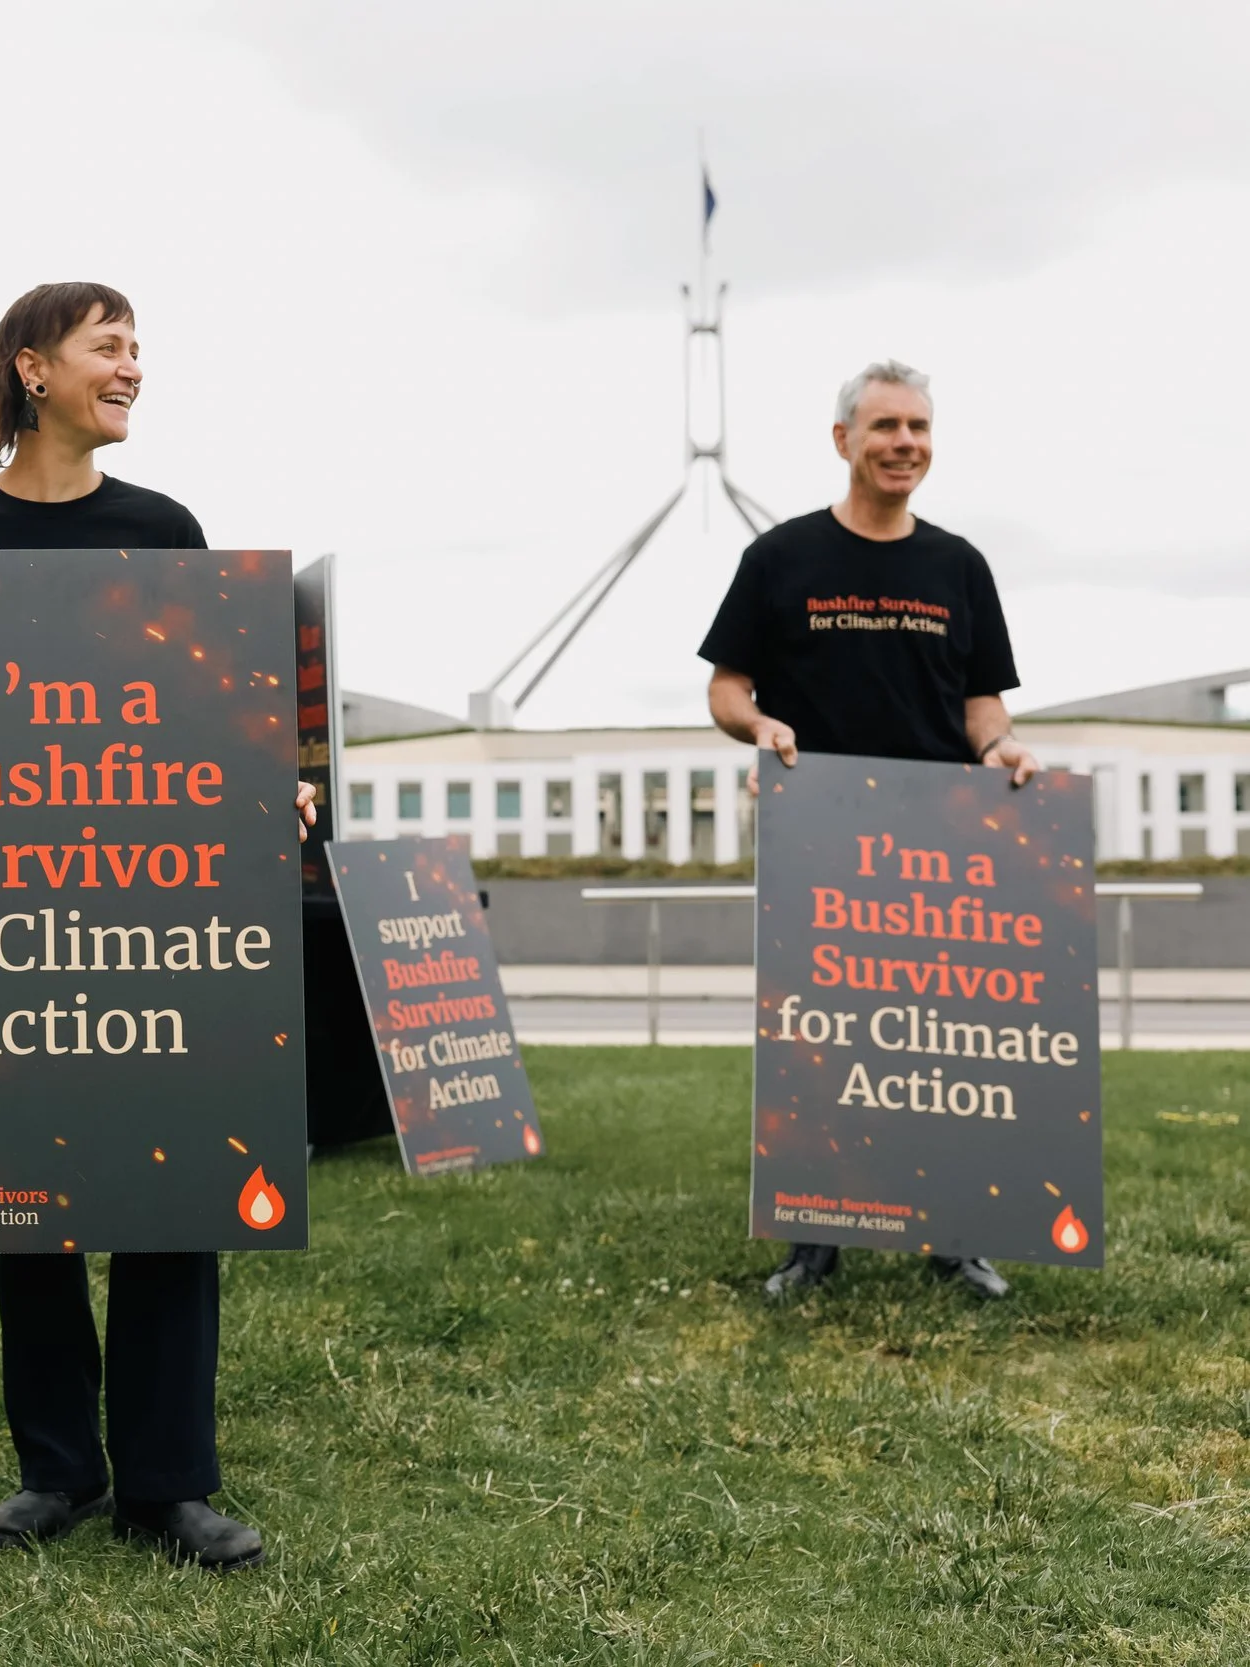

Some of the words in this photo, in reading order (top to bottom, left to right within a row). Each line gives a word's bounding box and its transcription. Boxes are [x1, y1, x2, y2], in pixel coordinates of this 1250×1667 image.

[122, 682, 160, 724] a
[858, 834, 951, 882] I’m
[966, 854, 995, 886] a
[405, 871, 419, 901] I
[379, 910, 466, 949] support
[812, 887, 1043, 948] Bushfire
[382, 951, 481, 990] Bushfire
[812, 944, 1045, 1004] Survivor
[388, 992, 496, 1030] Survivors
[778, 995, 857, 1046] for
[870, 1006, 1078, 1065] Climate
[390, 1039, 426, 1073] for
[429, 1029, 513, 1067] Climate
[430, 1071, 501, 1109] Action
[838, 1063, 1017, 1120] Action
